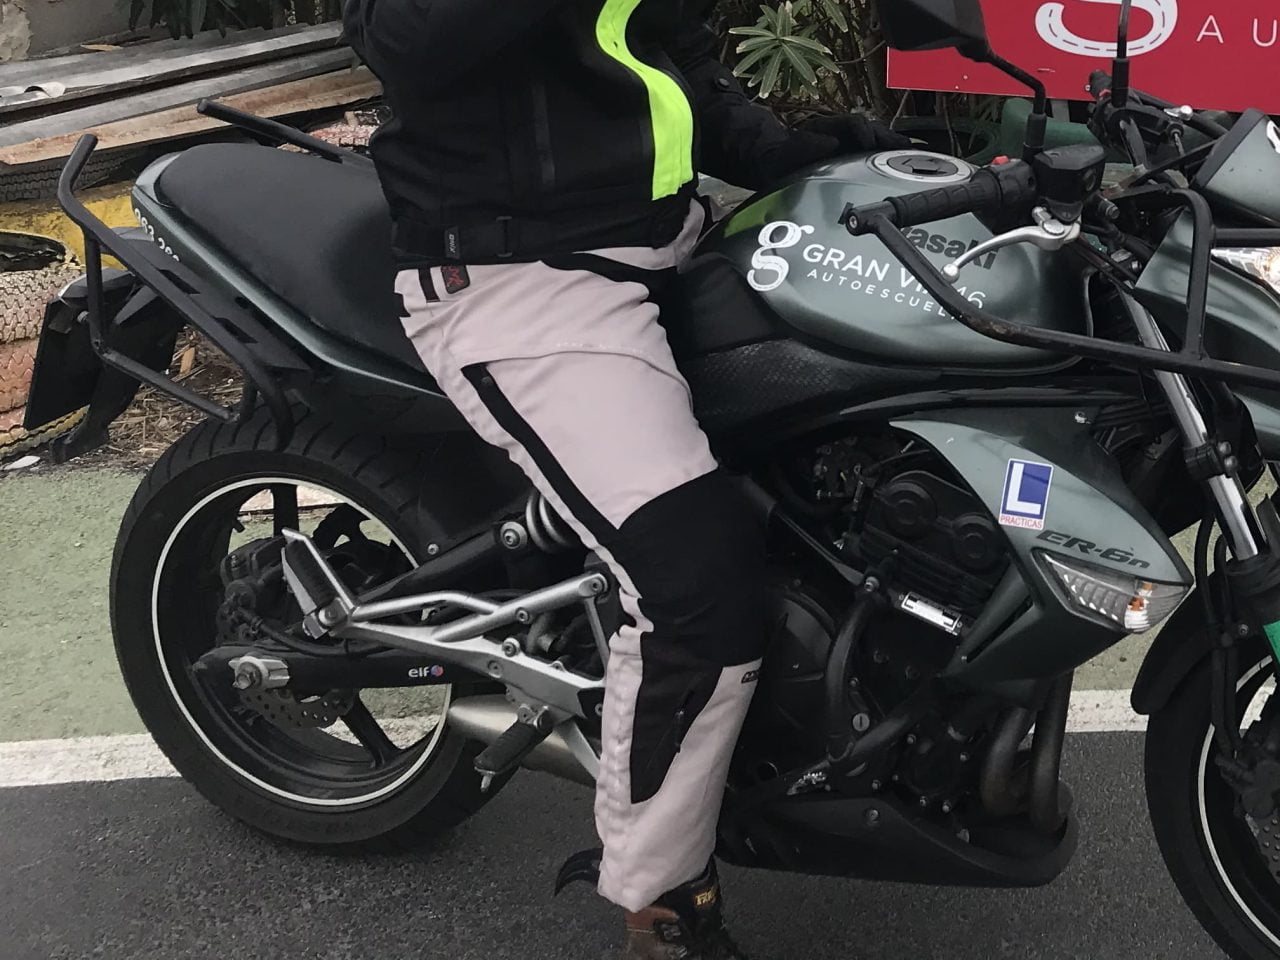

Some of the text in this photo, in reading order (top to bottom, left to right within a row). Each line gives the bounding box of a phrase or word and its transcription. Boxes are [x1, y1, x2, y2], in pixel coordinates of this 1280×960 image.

[802, 243, 890, 282] GRAN
[806, 268, 955, 319] AUTOESCUEL
[1005, 462, 1042, 515] L
[1036, 529, 1151, 569] ER-6n
[408, 666, 430, 678] elf
